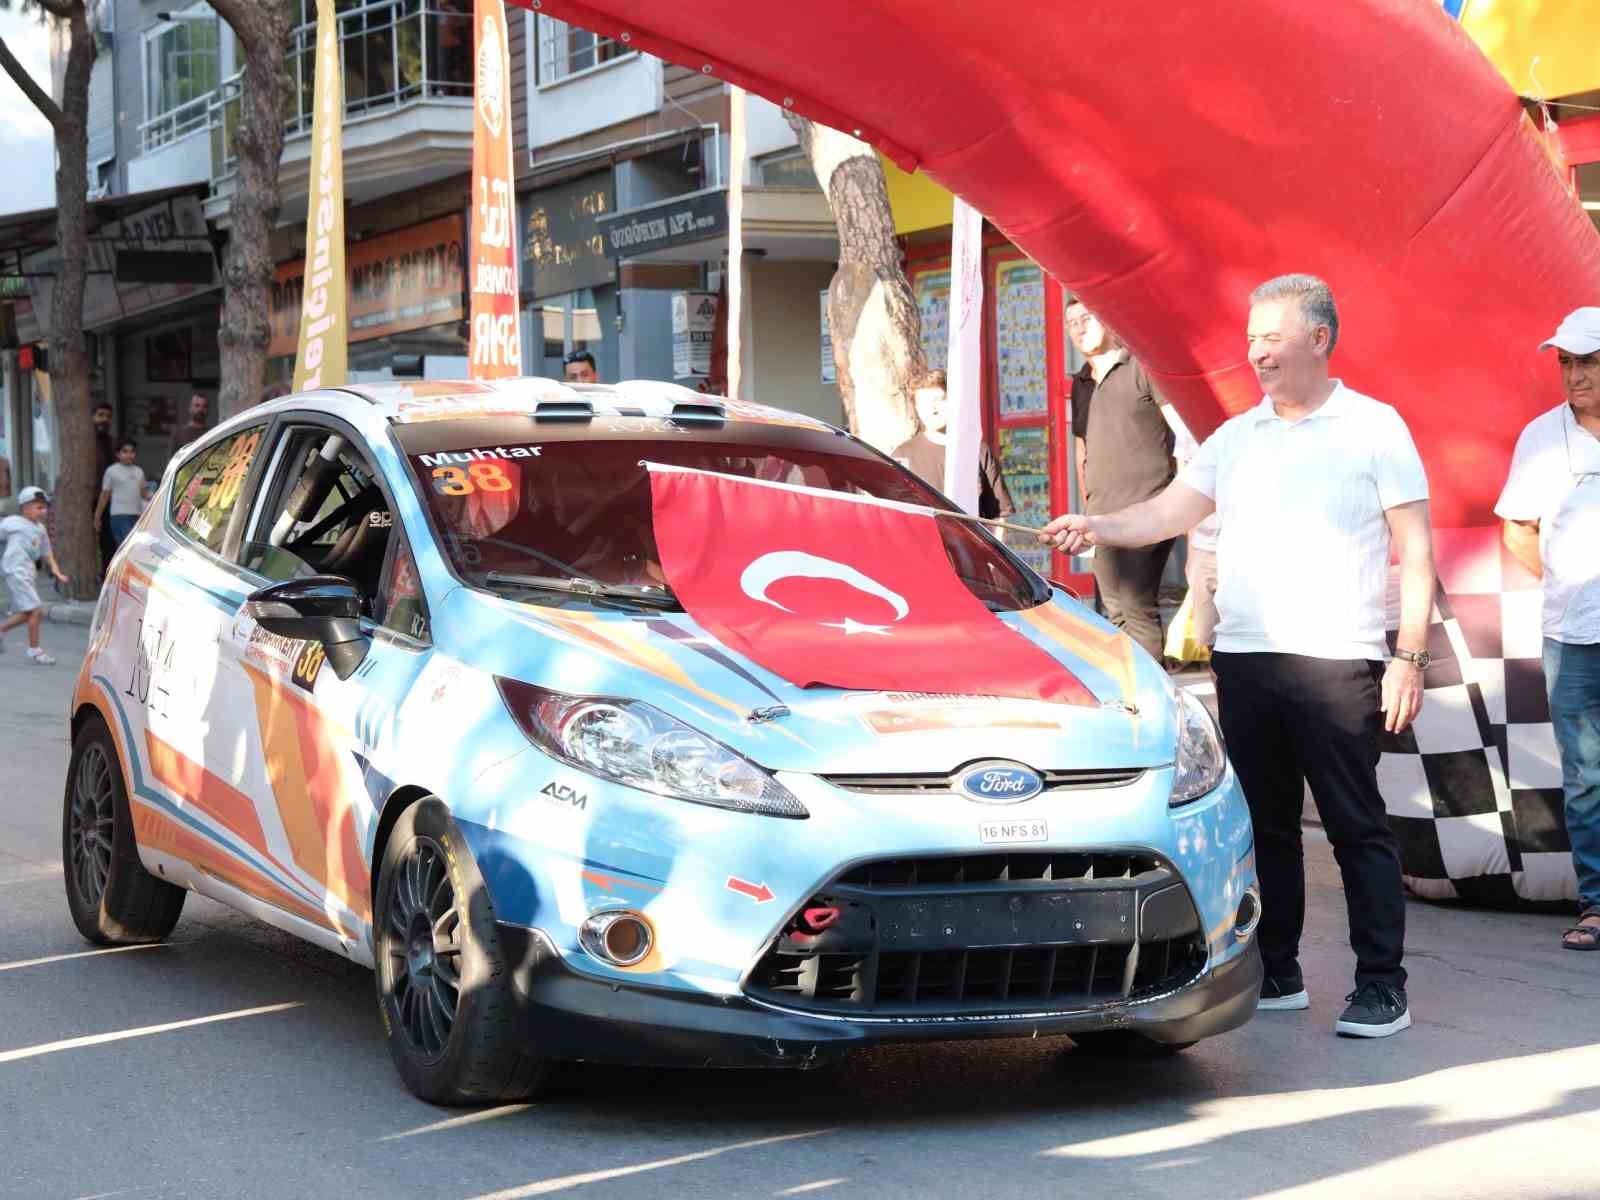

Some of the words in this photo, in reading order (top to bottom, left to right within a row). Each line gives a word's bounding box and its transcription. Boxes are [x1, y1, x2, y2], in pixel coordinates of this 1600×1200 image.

[419, 446, 543, 467] Muhtar
[431, 463, 513, 496] 38
[980, 771, 1025, 793] Ford
[983, 825, 998, 838] 16
[1001, 824, 1029, 838] NFS
[1031, 823, 1046, 837] 81
